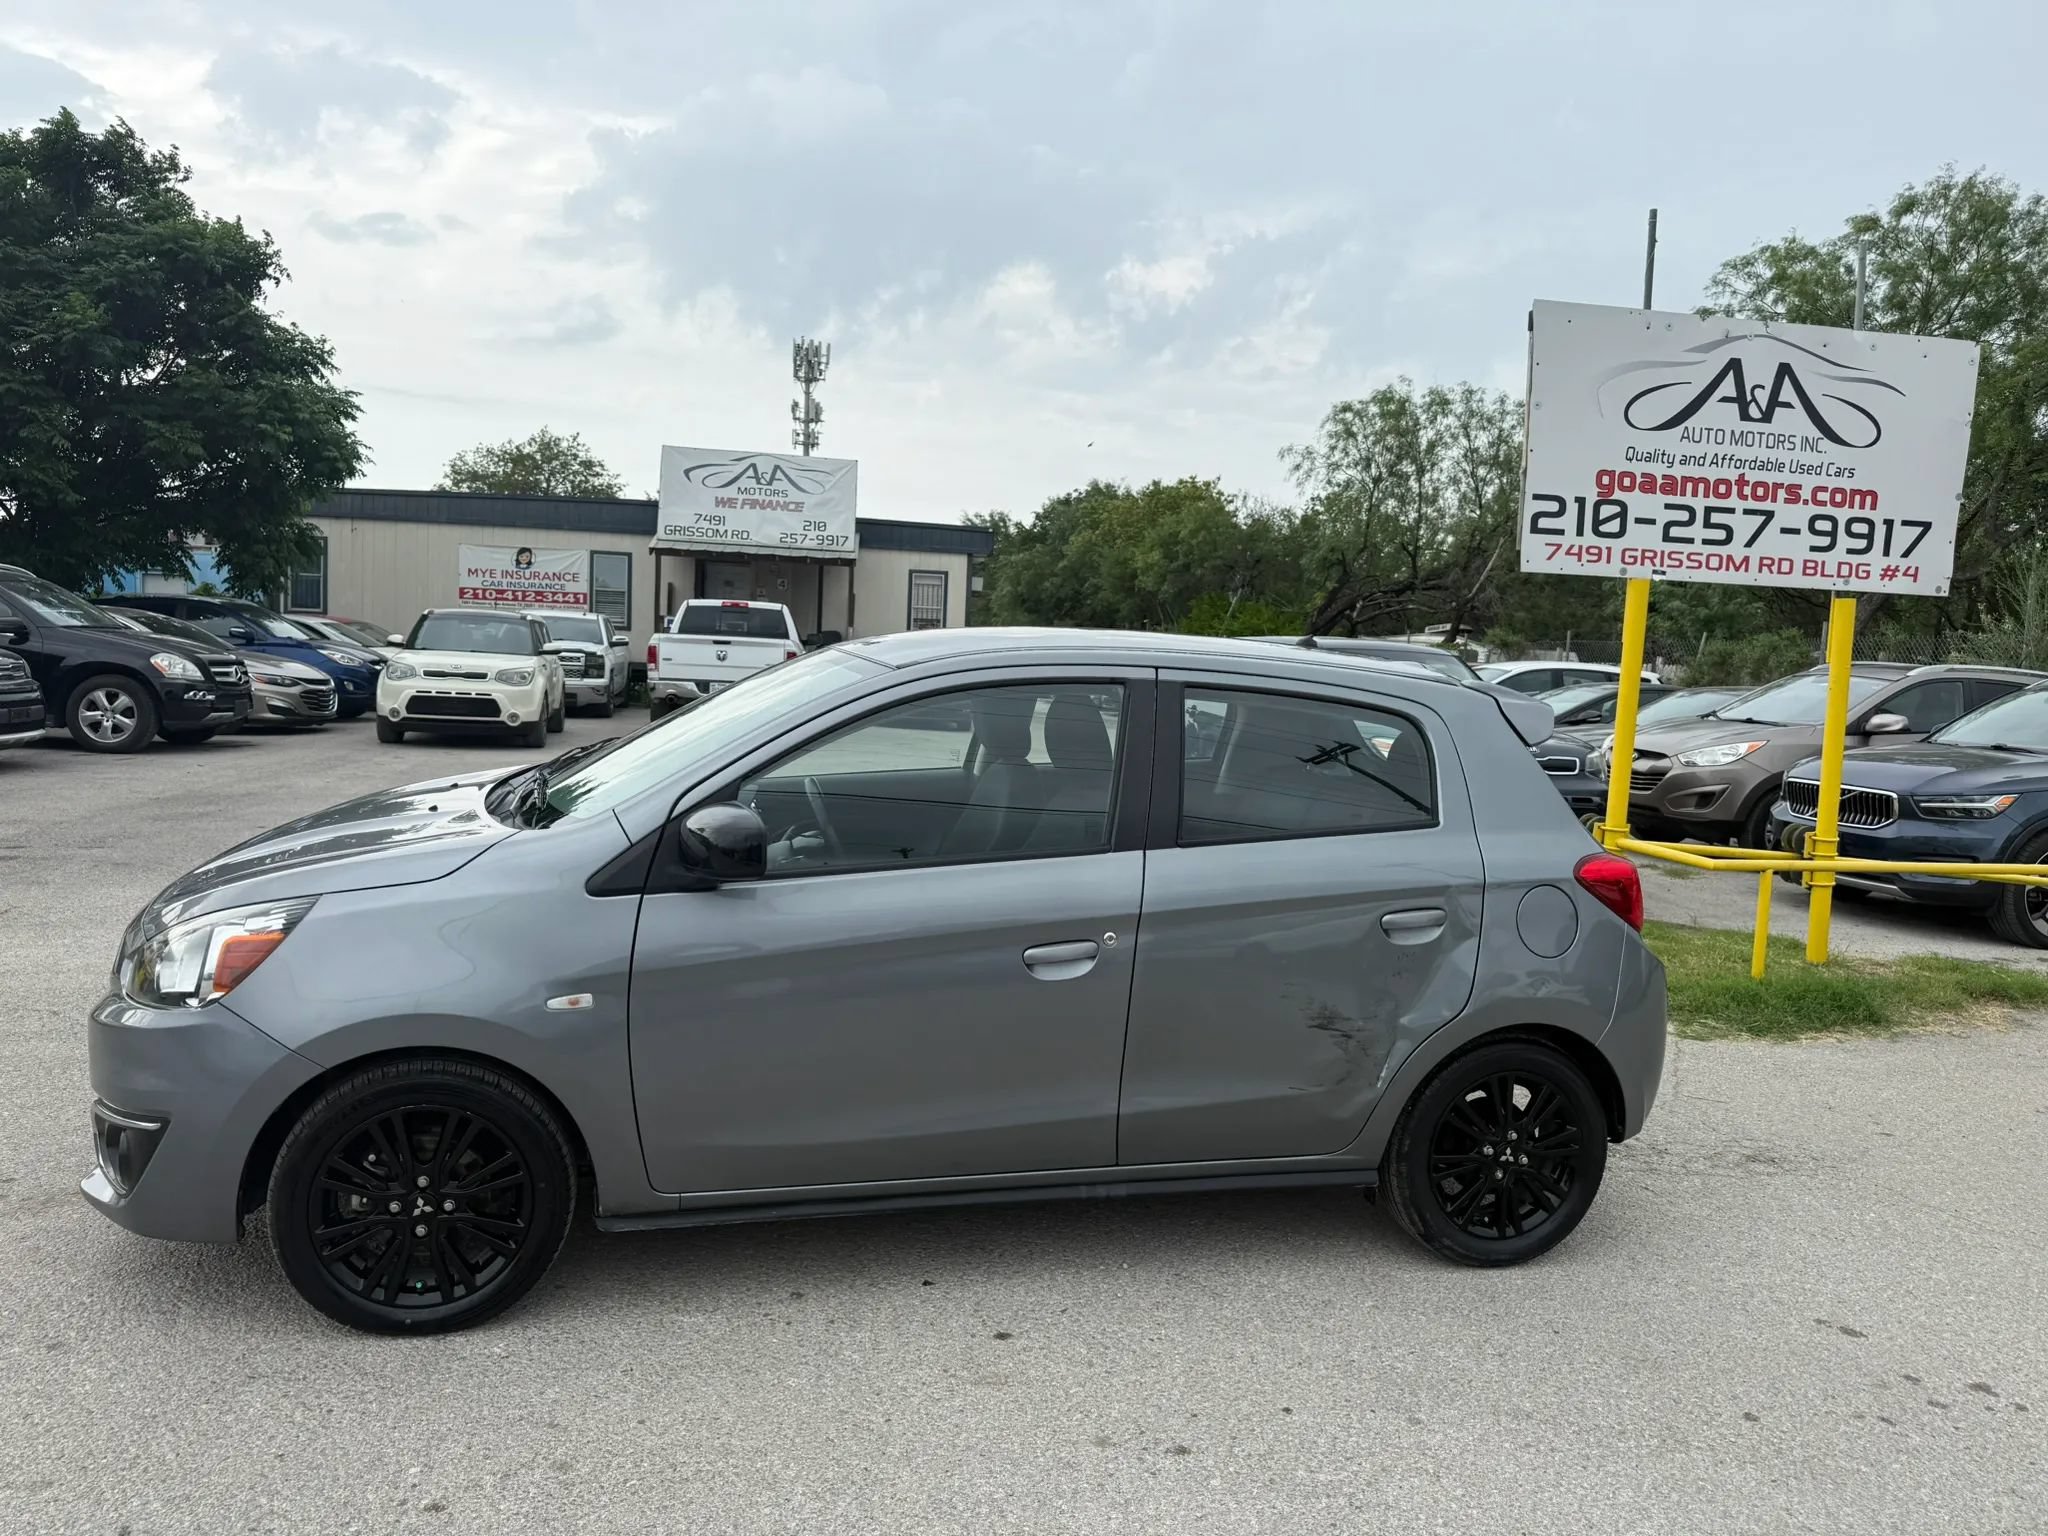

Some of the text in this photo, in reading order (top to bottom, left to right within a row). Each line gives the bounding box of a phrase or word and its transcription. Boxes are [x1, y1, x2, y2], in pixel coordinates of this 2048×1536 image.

[1679, 426, 1827, 454] AUTO MOTORS INC.
[1625, 446, 1856, 479] Quality and Affordable Used Cars
[737, 487, 788, 498] MOTORS
[1595, 468, 1878, 511] goaamotors.com
[715, 496, 805, 513] WE FINANCE
[694, 513, 726, 525] 7491
[1529, 493, 1932, 558] 210-257-9917
[664, 525, 752, 540] GRISSOM RD.
[802, 521, 826, 532] 210
[779, 533, 849, 547] 257-9917
[1545, 543, 1920, 583] 7491 GRISSOM RD BLDG #4
[468, 568, 580, 582] MYE INSURANCE
[481, 580, 565, 591] CAR INSURANCE
[463, 589, 584, 603] 210-412-3441
